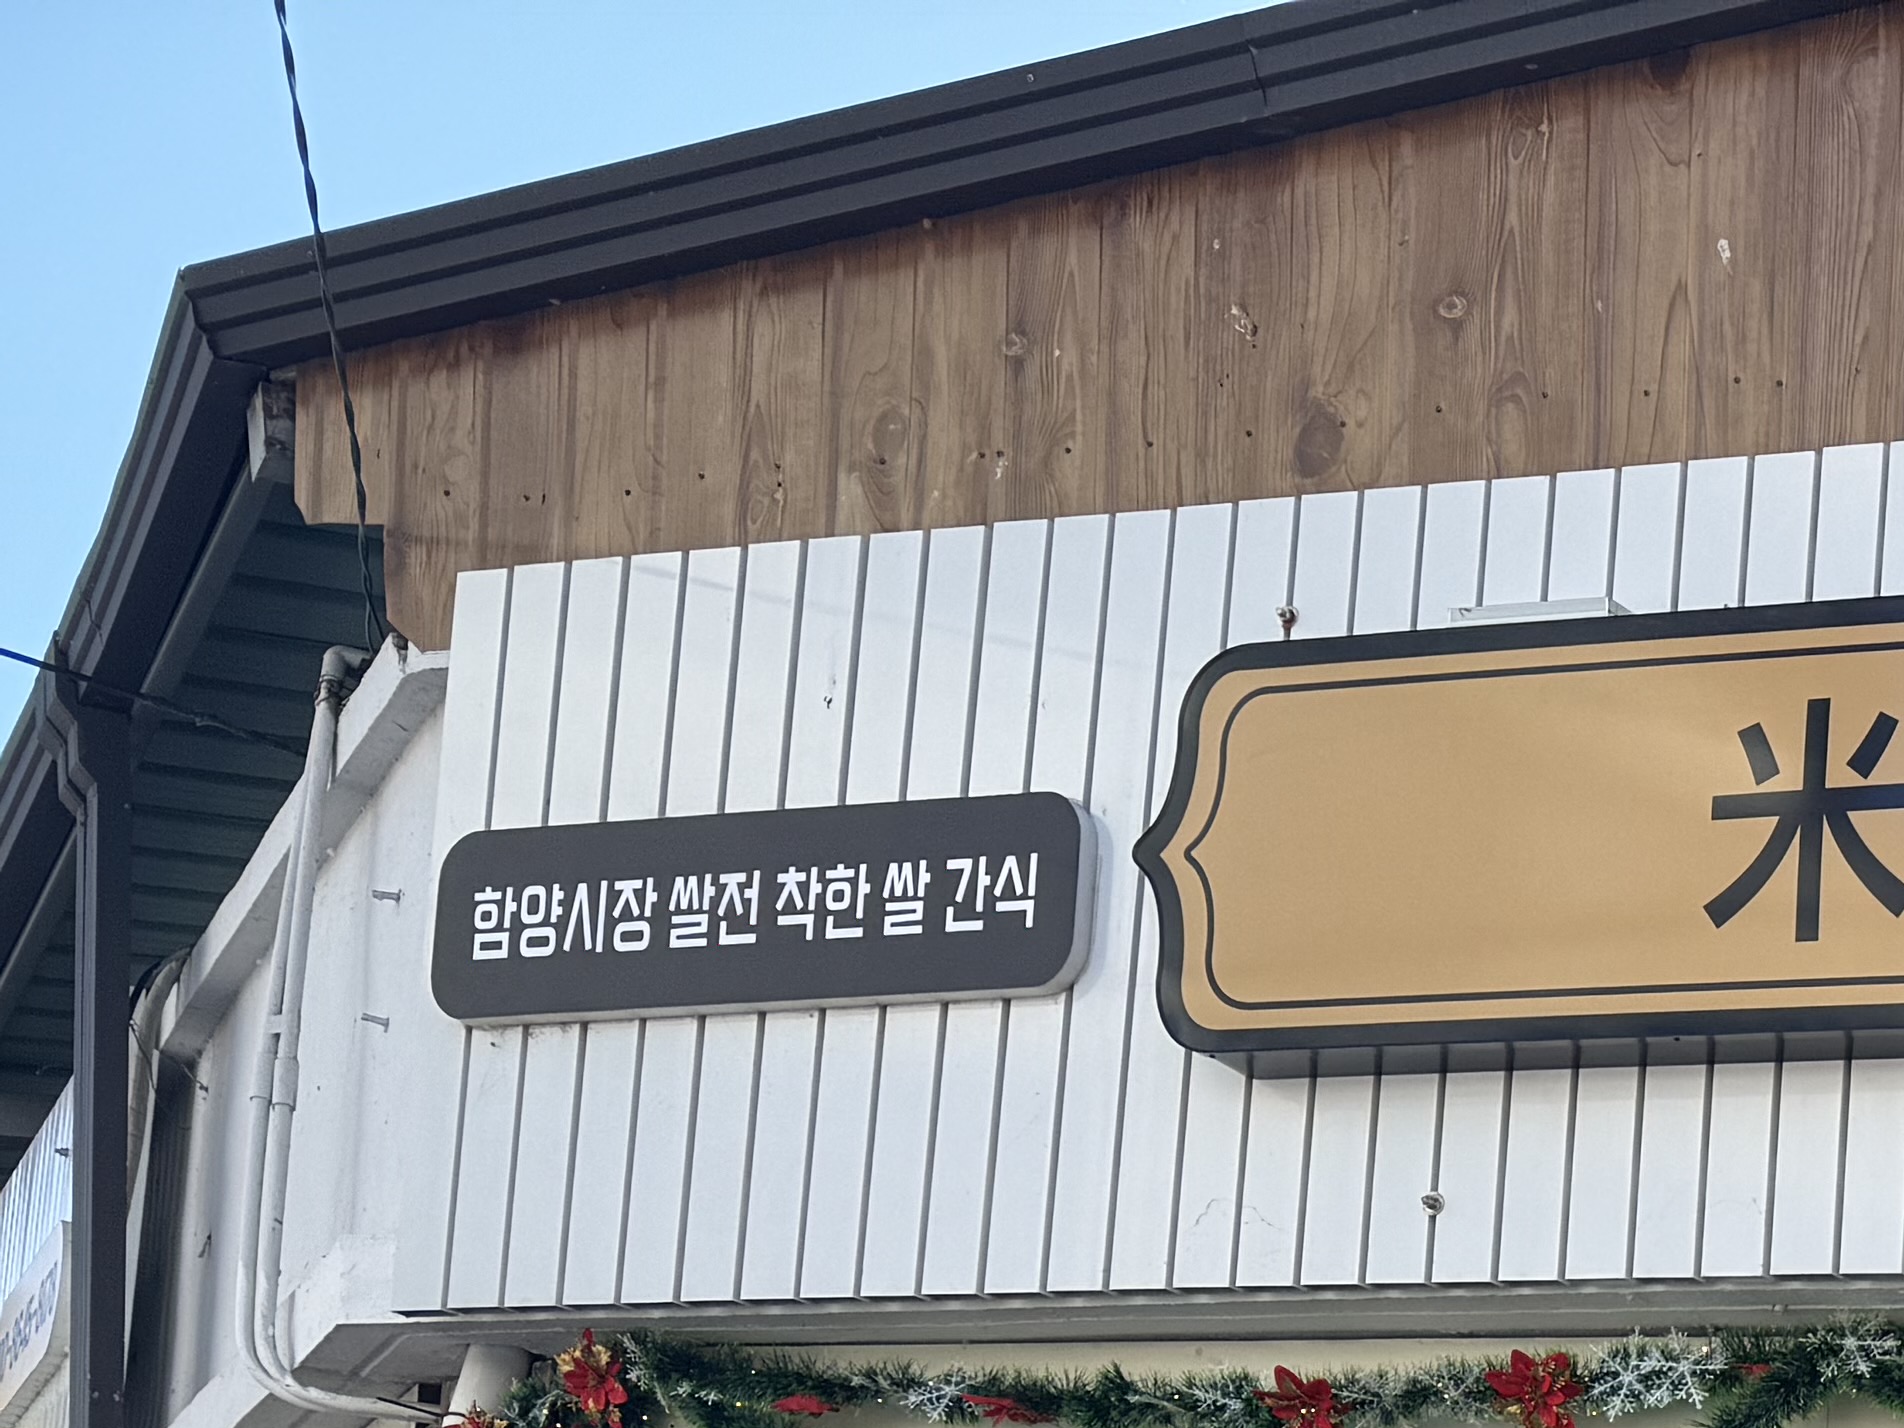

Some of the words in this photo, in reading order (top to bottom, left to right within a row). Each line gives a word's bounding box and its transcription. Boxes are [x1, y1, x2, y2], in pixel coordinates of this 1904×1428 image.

[472, 878, 656, 961] 함양시장
[668, 869, 761, 949] 쌀전
[774, 862, 871, 941] 착한
[882, 858, 932, 937] 쌀
[943, 851, 1039, 932] 간식
